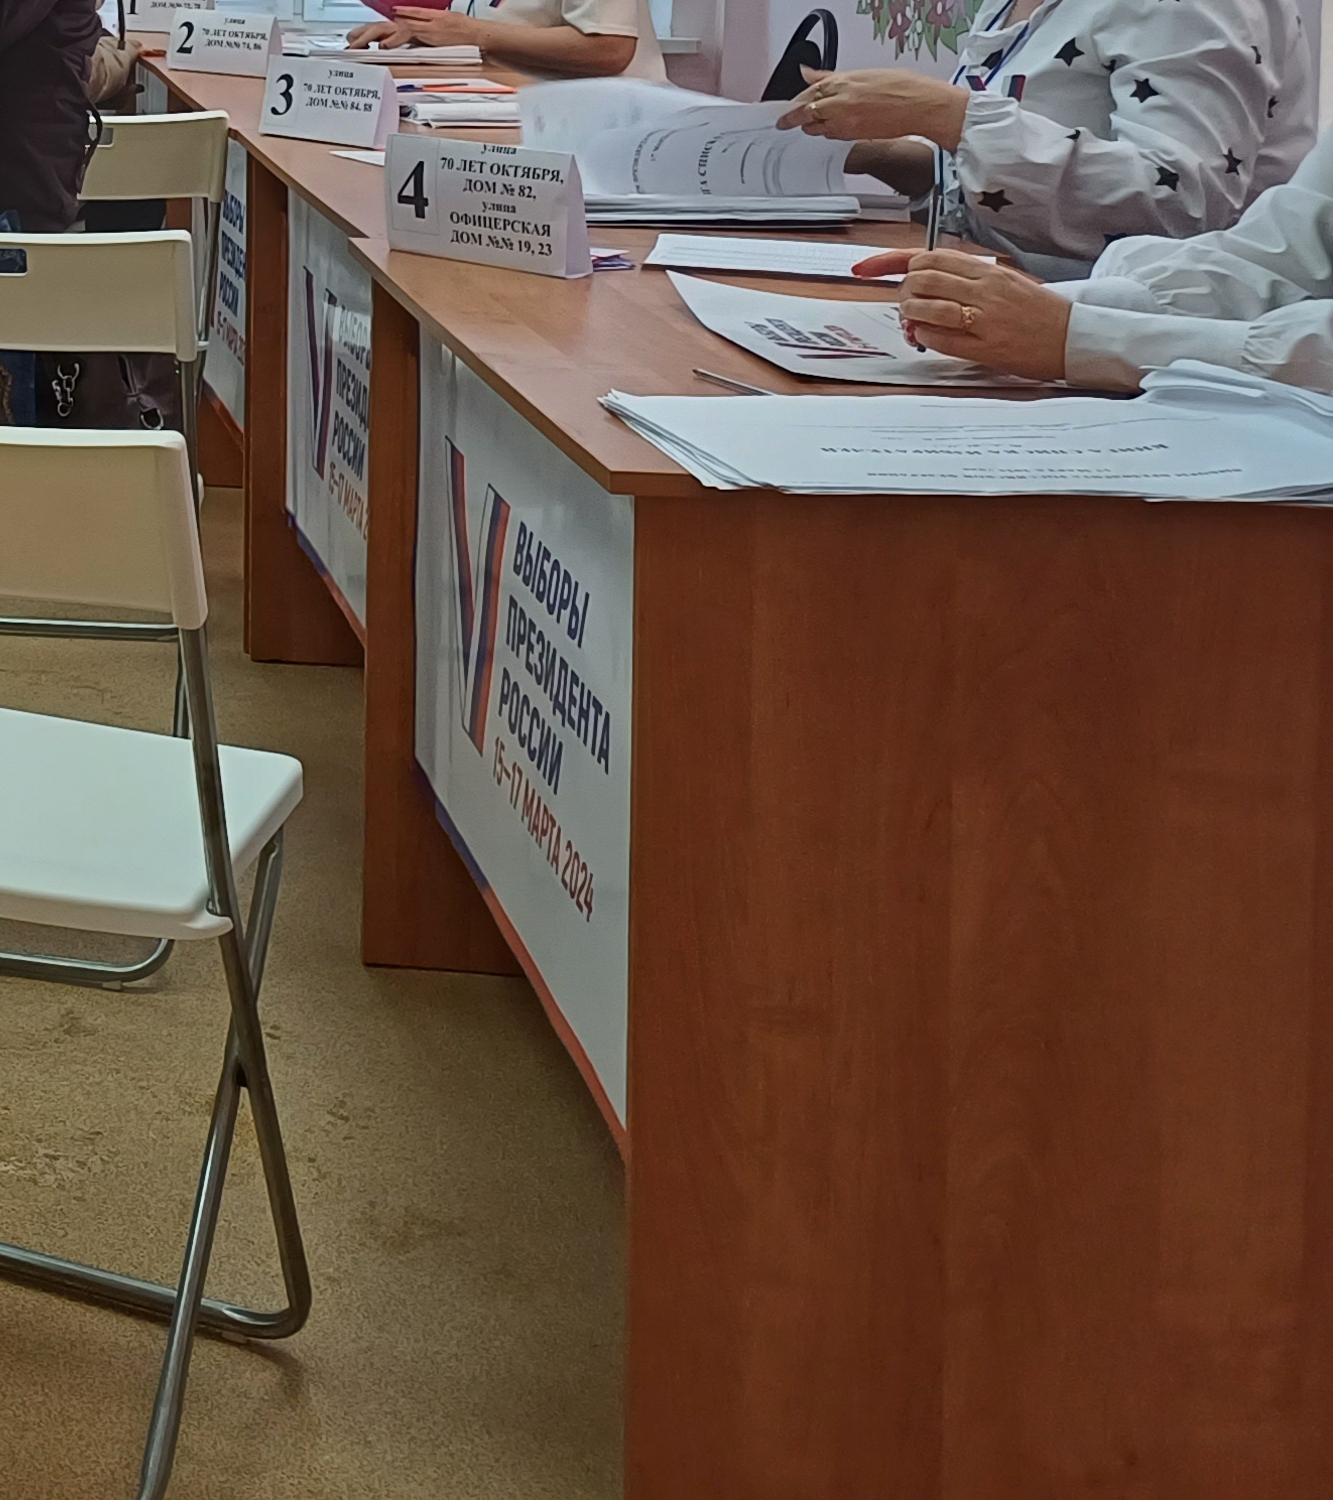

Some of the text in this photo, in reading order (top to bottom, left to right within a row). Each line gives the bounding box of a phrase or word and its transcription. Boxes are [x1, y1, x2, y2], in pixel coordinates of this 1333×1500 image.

[176, 21, 194, 54] 2
[270, 73, 294, 116] 3
[305, 97, 328, 107] ДОМ
[313, 84, 332, 94] ЛЕТ
[440, 157, 564, 184] 70 ЛЕТ ОКТЯБРЯ,
[397, 160, 429, 220] 4
[463, 178, 537, 200] ДОМ № 82,
[482, 201, 517, 214] улица
[449, 211, 551, 238] ОФИЦЕРСКАЯ
[450, 230, 483, 246] ДОМ
[517, 240, 535, 256] 19,
[538, 243, 553, 257] 23
[332, 410, 365, 481] РОССИИ
[512, 520, 590, 649] ВЫБОРЫ
[505, 594, 612, 776] ПРЕЗИДЕНТА
[498, 667, 564, 796] РОССИИ
[521, 778, 562, 875] МАРТА
[561, 840, 594, 923] 2024
